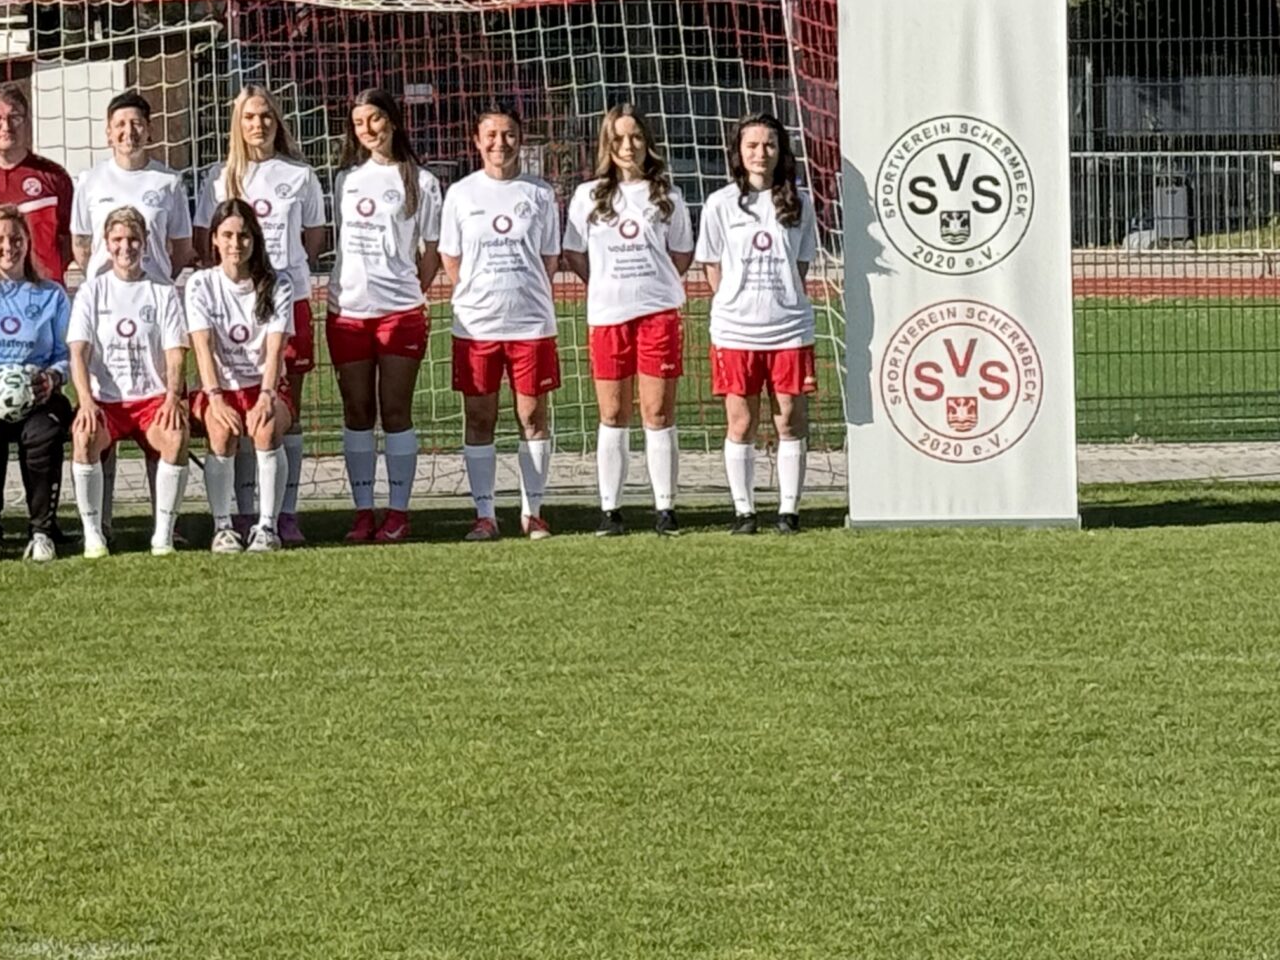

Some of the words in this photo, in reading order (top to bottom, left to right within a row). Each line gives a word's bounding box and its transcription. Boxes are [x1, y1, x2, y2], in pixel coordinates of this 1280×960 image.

[883, 122, 951, 218] SPORTVEREIN
[959, 123, 1028, 219] SCHERMBECK
[908, 153, 1002, 215] SVS
[912, 245, 956, 269] 2020
[888, 307, 957, 405] SPORTVEREIN
[966, 307, 1036, 405] SCHERMBECK
[914, 338, 1010, 401] SVS
[918, 433, 963, 457] 2020
